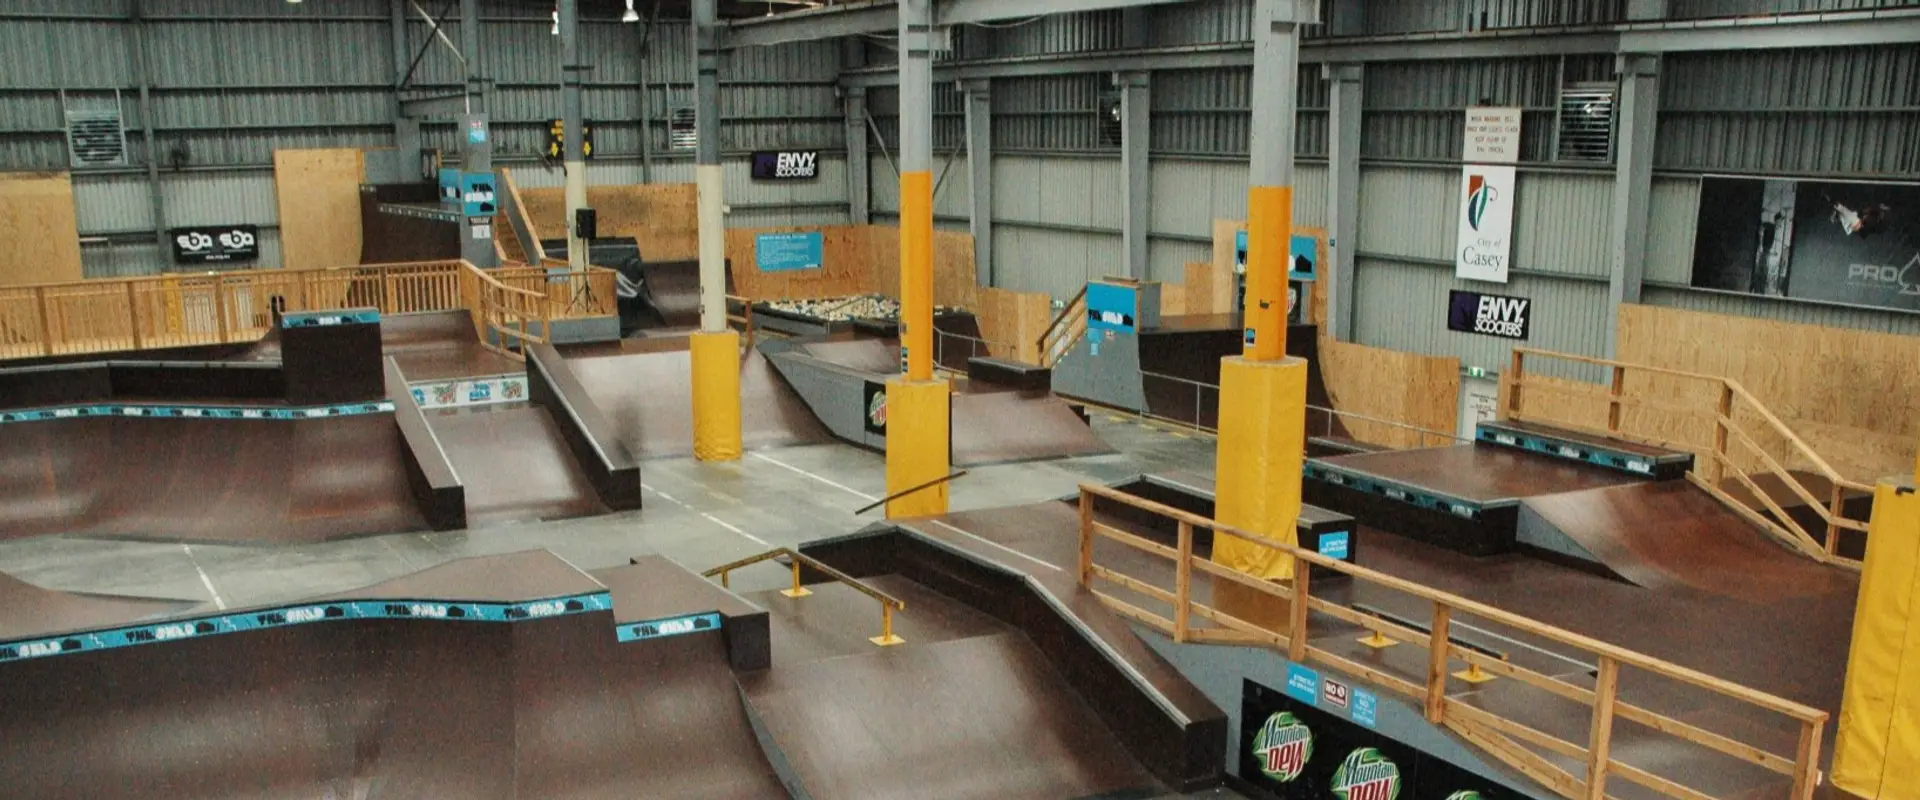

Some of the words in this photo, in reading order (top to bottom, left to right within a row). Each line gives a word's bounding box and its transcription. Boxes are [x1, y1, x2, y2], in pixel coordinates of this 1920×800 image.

[1463, 246, 1503, 271] Casey
[1848, 263, 1899, 283] PRO
[1474, 318, 1523, 337] SCOOTERS
[1325, 682, 1337, 695] NO
[1262, 716, 1308, 750] Mountain
[1340, 752, 1395, 788] Mountain
